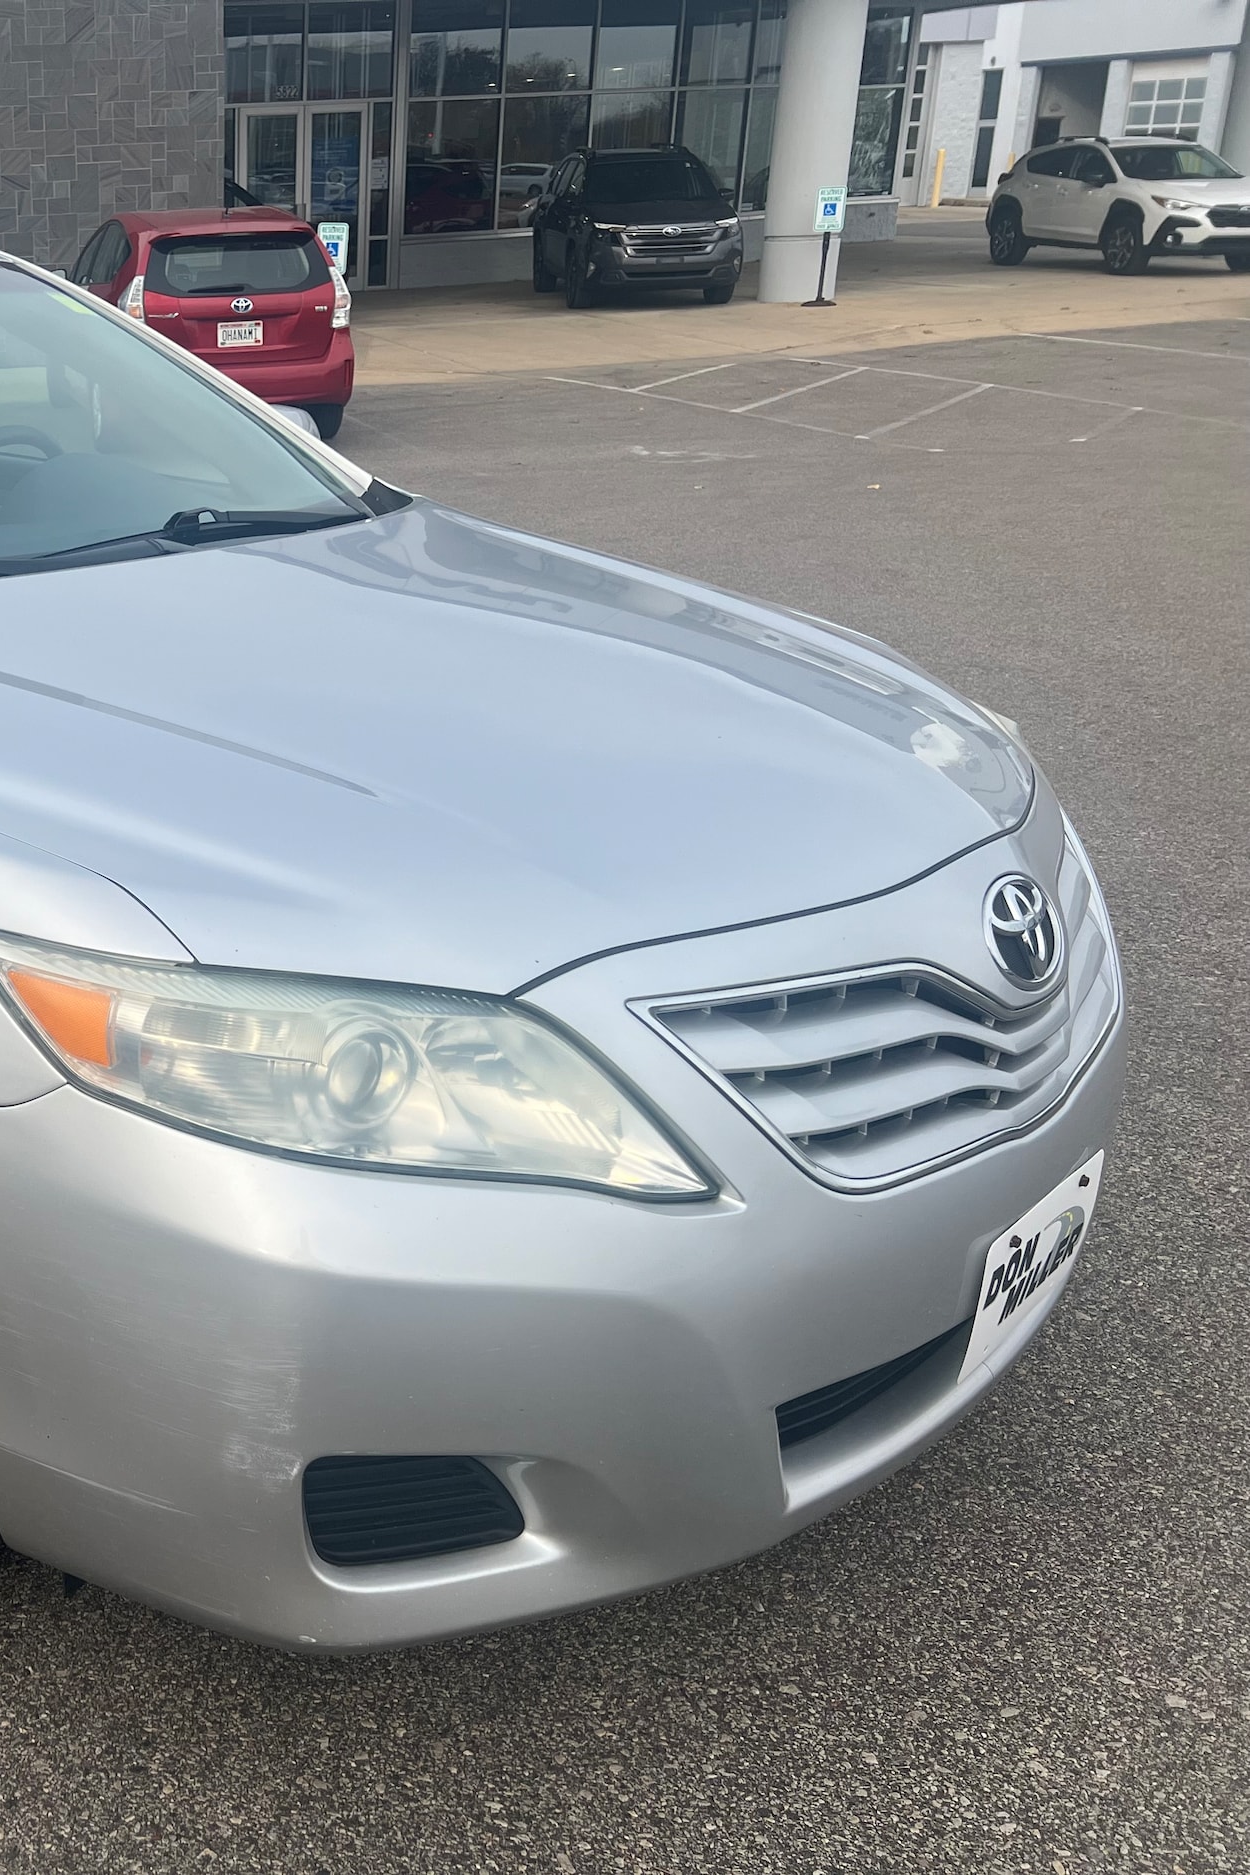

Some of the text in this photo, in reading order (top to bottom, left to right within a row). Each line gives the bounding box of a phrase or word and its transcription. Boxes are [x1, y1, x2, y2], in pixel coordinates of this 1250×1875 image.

[222, 328, 258, 342] OHANAMI
[983, 1231, 1041, 1311] DON
[997, 1222, 1084, 1326] MILLER
